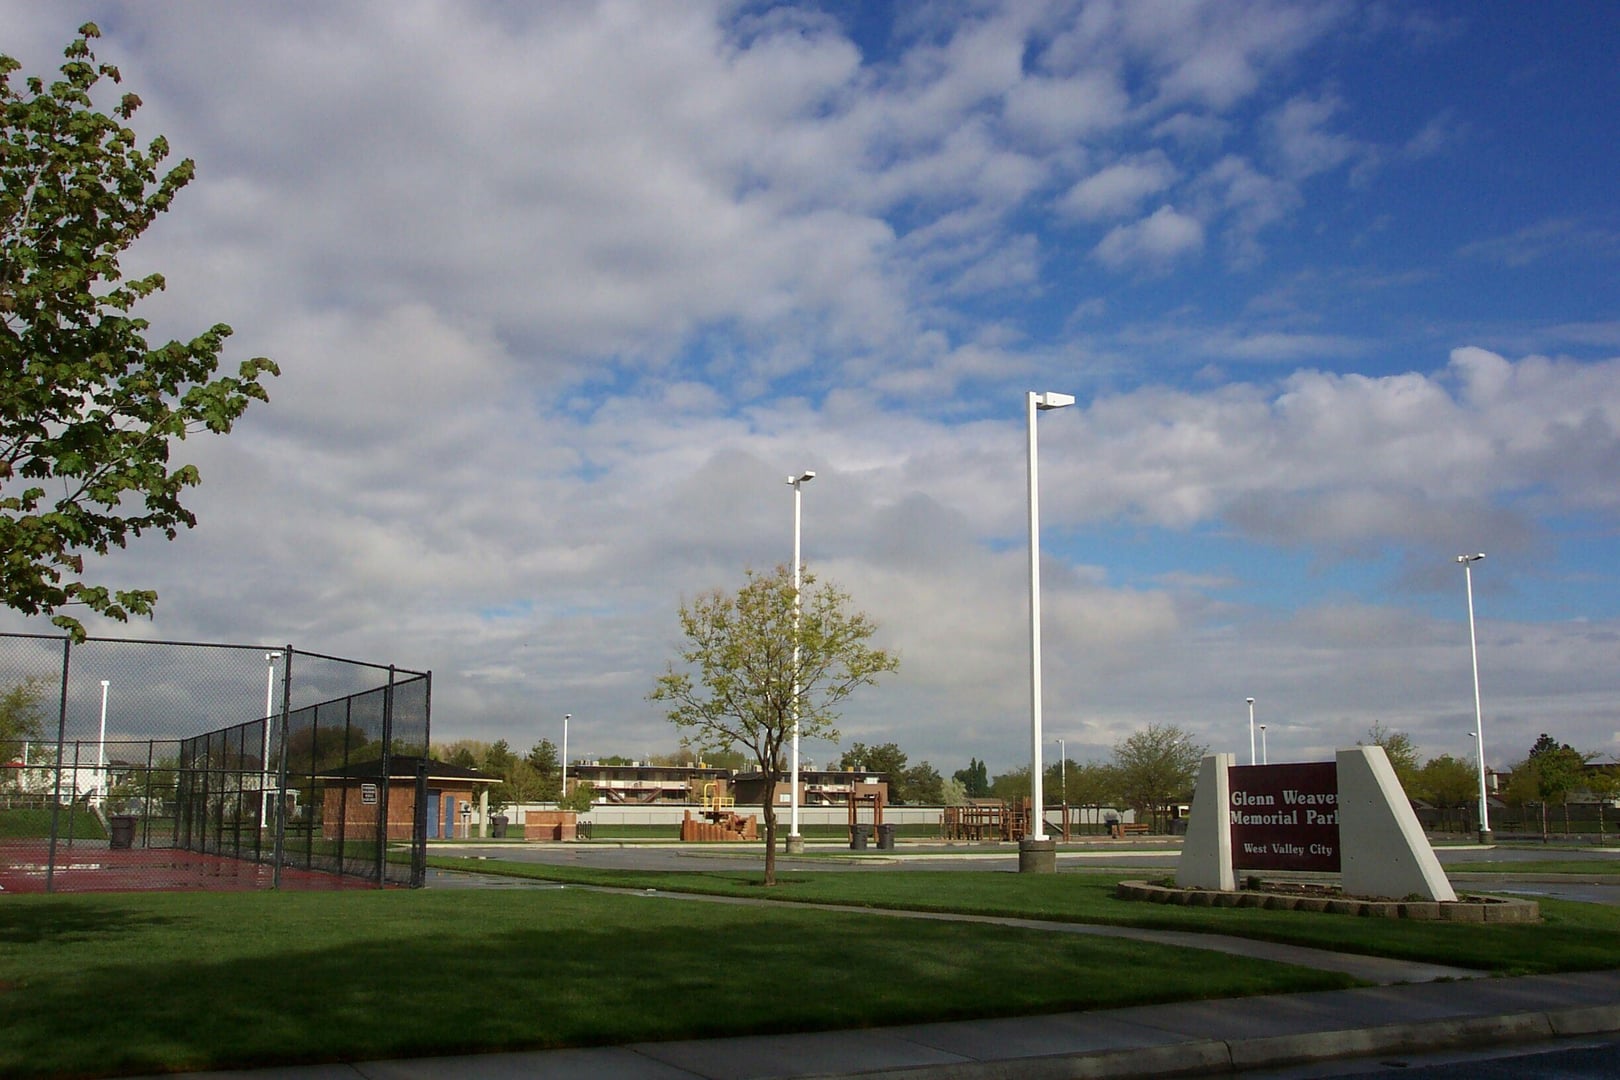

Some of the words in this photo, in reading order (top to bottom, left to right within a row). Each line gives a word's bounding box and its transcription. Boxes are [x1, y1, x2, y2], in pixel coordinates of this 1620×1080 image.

[1231, 791, 1275, 806] Glenn
[1230, 810, 1298, 825] Memorial
[1244, 843, 1268, 854] West
[1272, 844, 1304, 856] Valley
[1310, 844, 1333, 856] City
